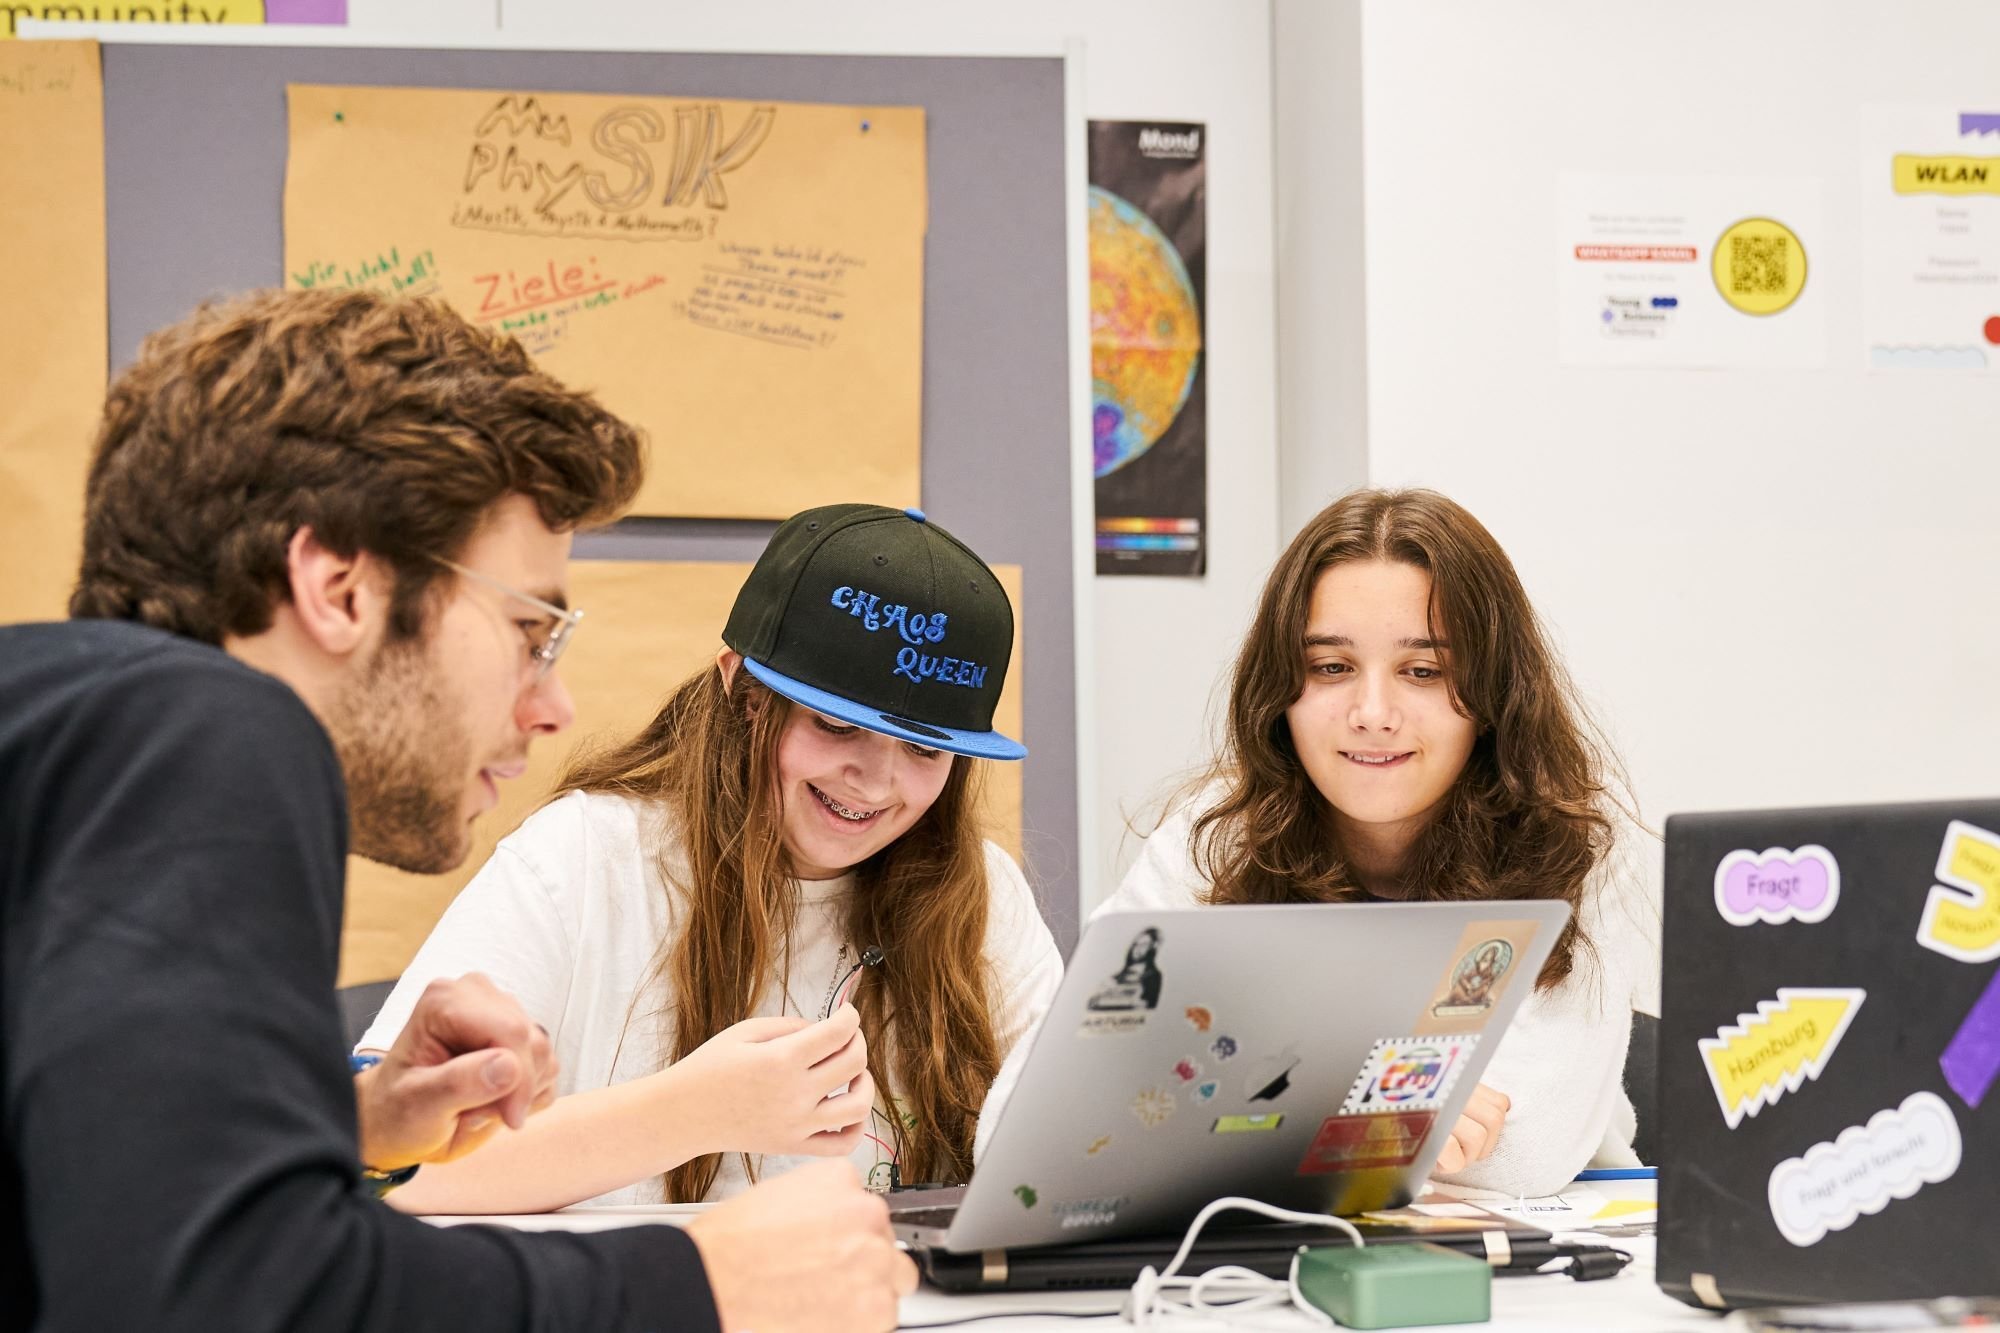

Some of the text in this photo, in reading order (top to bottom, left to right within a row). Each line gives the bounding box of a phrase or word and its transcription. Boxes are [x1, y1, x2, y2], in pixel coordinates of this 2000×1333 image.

[474, 95, 571, 147] My
[1138, 128, 1199, 151] Mond
[1915, 165, 1989, 184] WLAN
[473, 255, 602, 313] Ziele:
[831, 586, 949, 645] CHAOS
[893, 647, 988, 688] QUEEN
[1747, 874, 1800, 898] Fragt
[1727, 1018, 1817, 1081] Hamburg
